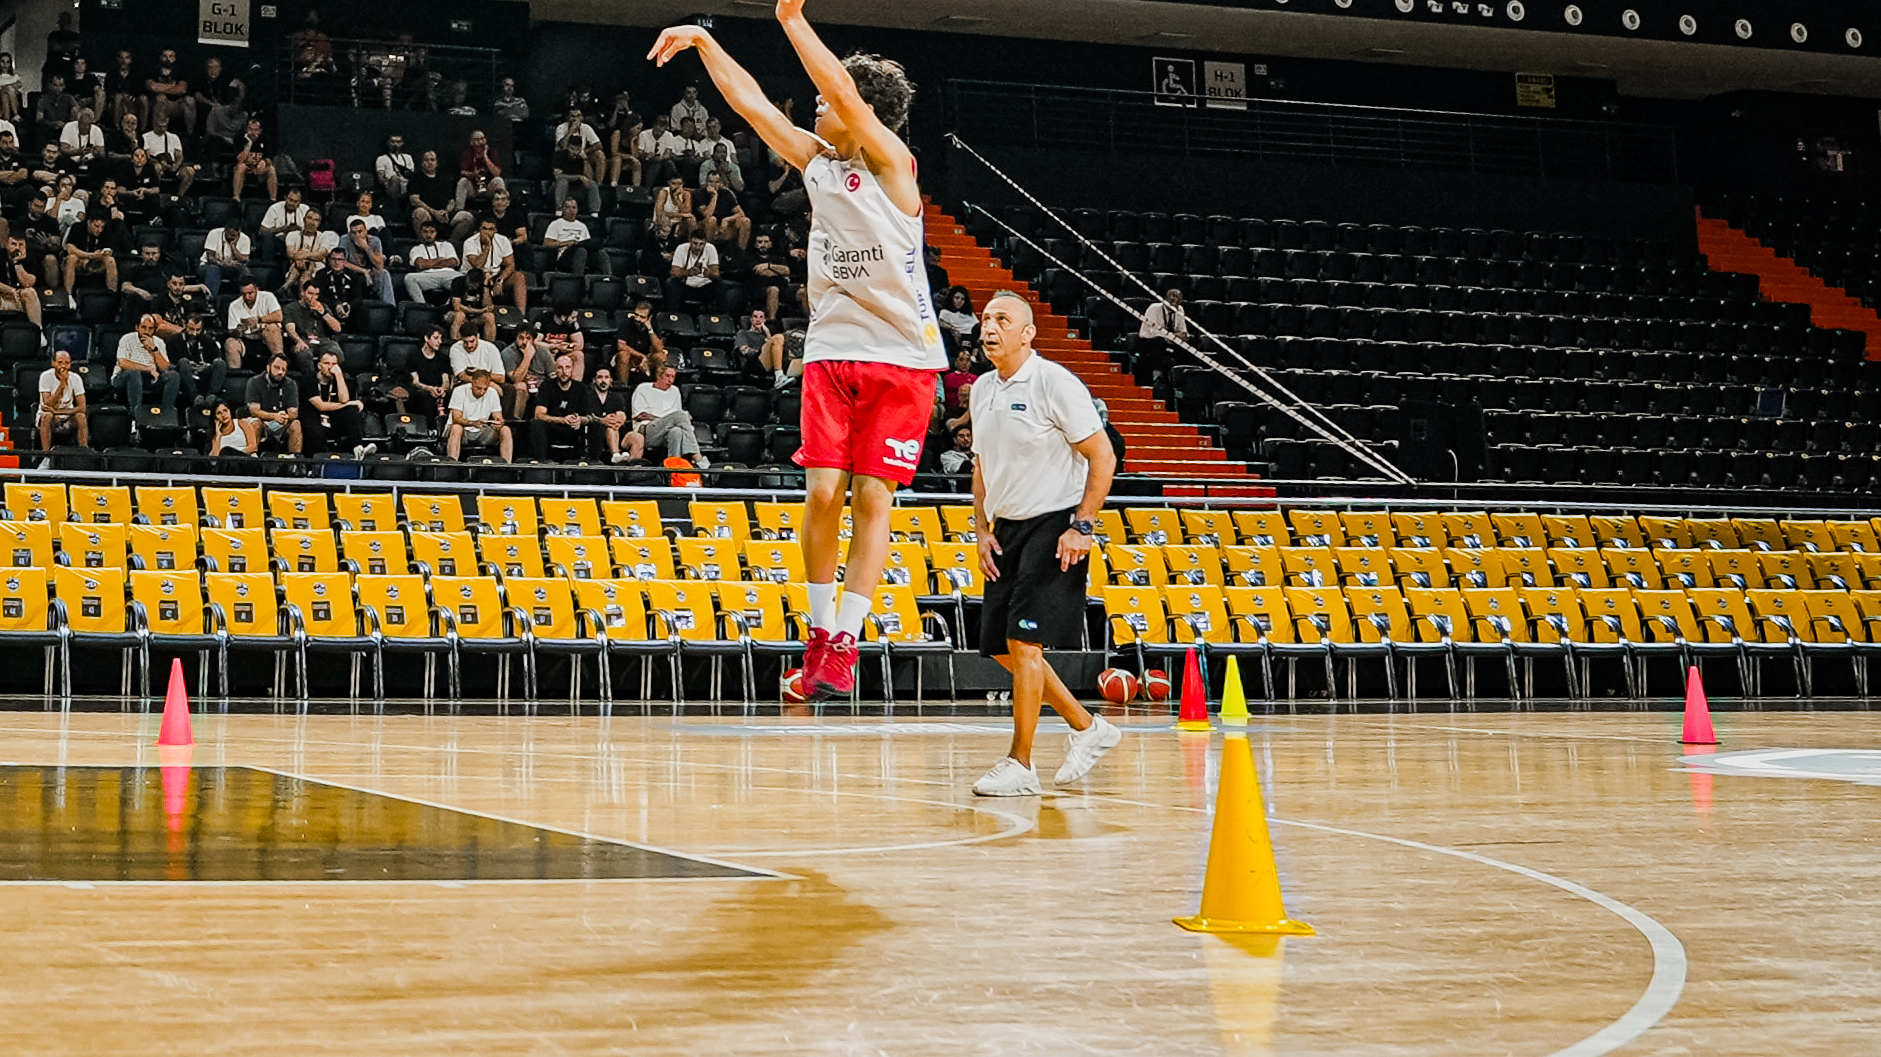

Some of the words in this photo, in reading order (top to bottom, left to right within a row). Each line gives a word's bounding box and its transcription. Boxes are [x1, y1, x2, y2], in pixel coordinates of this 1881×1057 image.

[212, 3, 236, 17] G-1
[202, 20, 245, 36] BLOK
[1214, 70, 1236, 83] H-1
[832, 245, 884, 263] Garanti
[833, 266, 870, 280] BBVA
